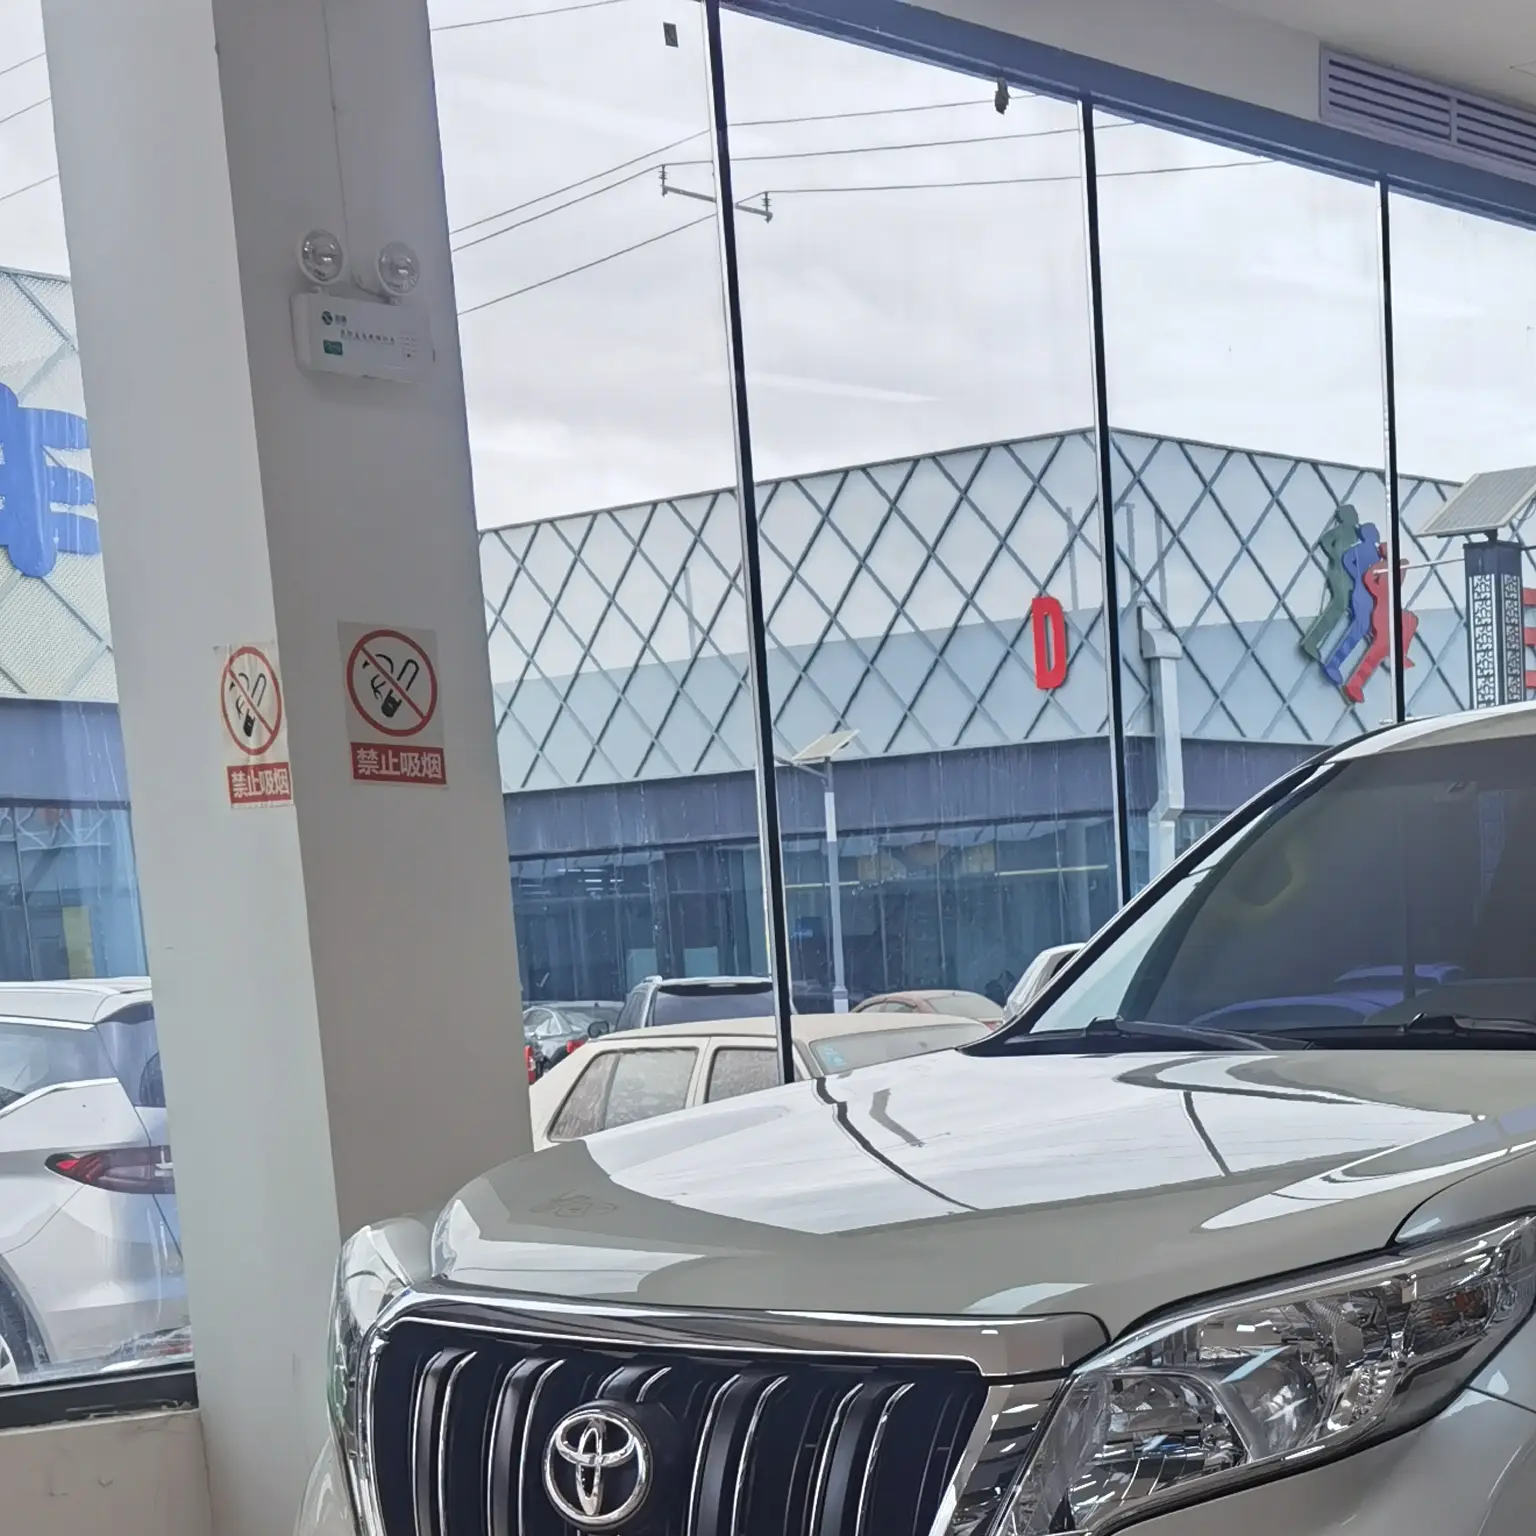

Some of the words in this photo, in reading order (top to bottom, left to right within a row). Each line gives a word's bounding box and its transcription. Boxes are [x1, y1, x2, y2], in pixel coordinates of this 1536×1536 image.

[1031, 596, 1068, 690] D
[357, 748, 443, 779] 禁止吸烟
[231, 767, 290, 798] 禁止吸烟
